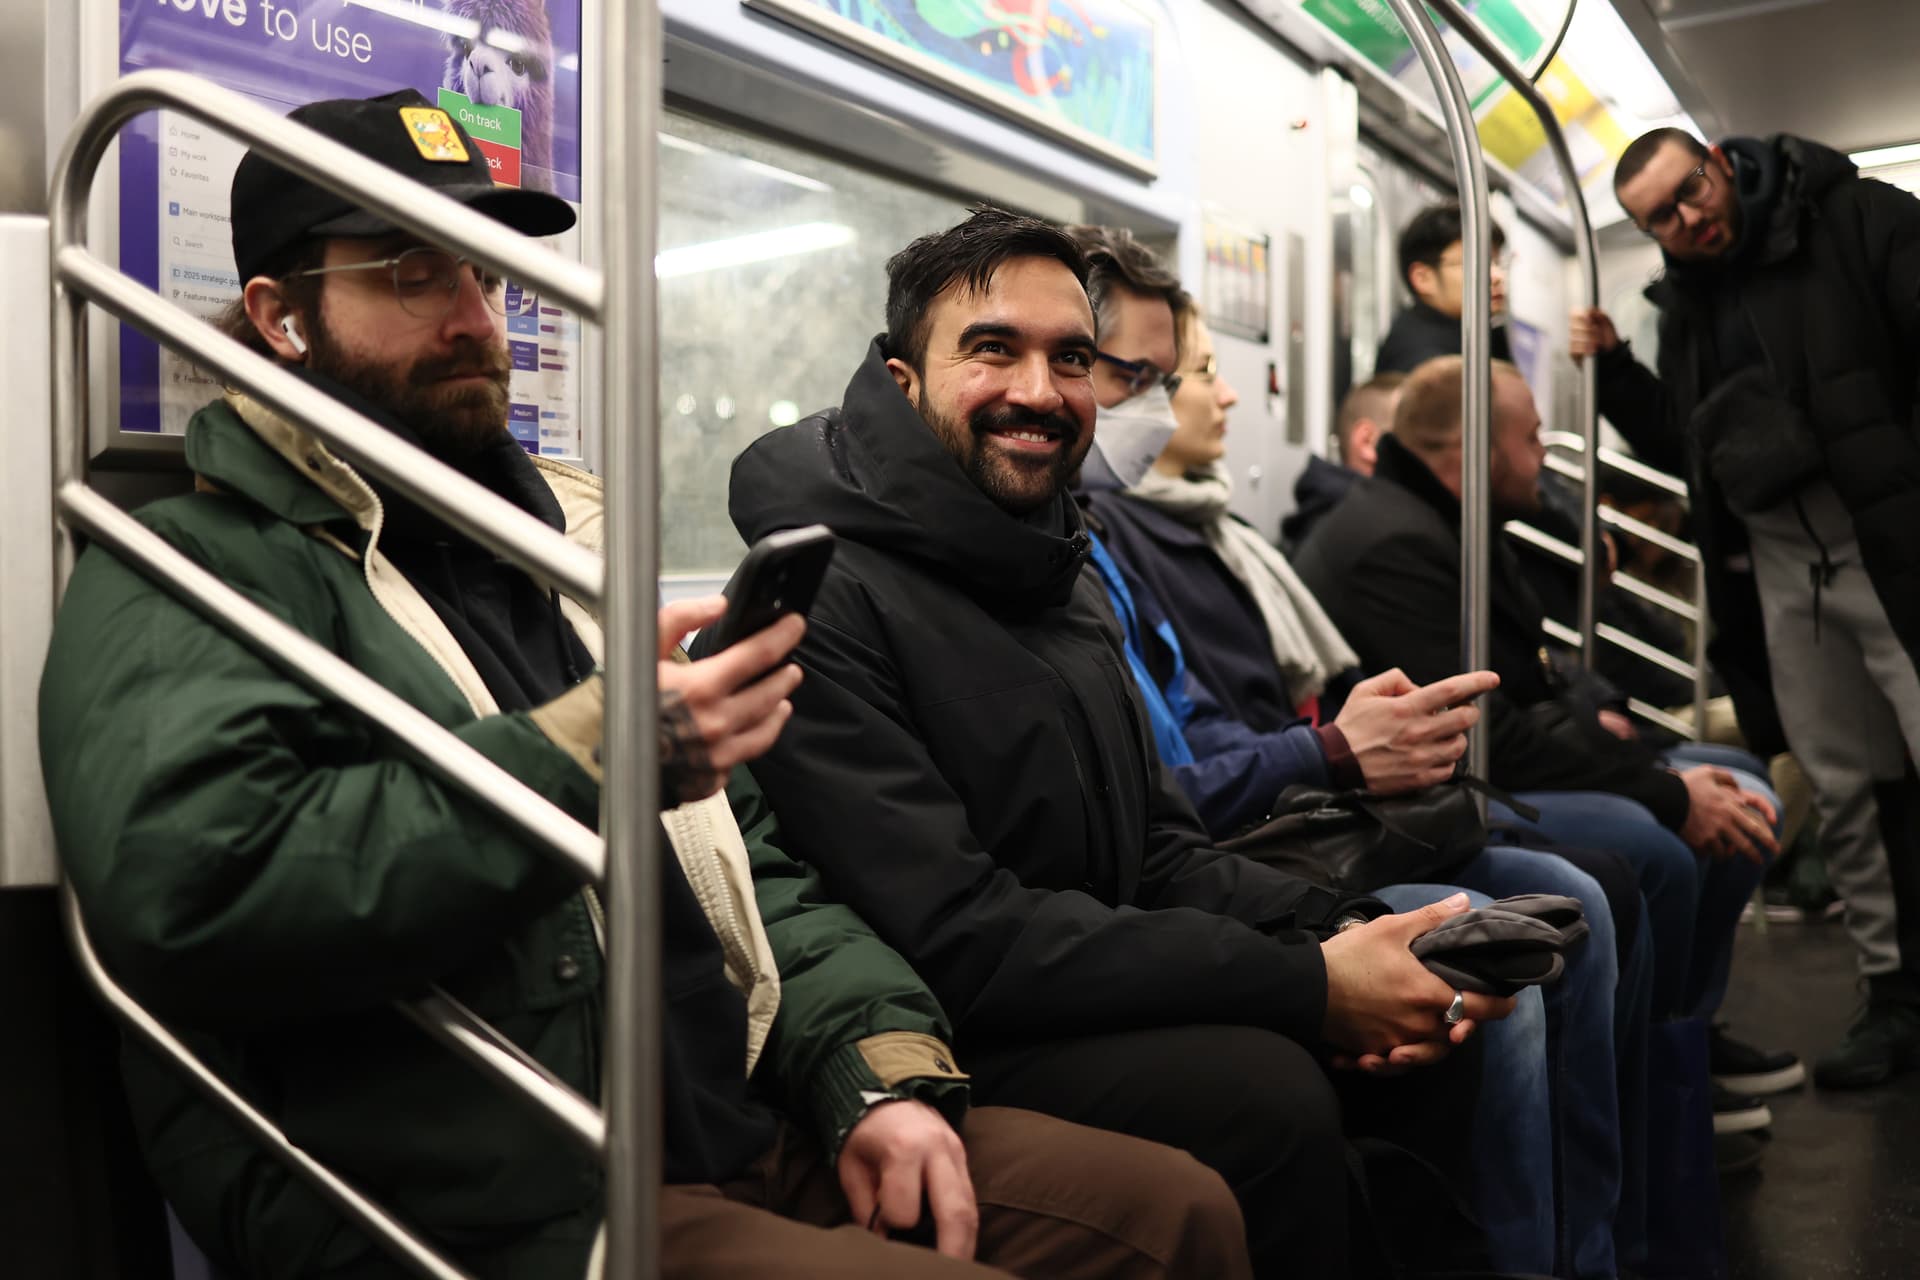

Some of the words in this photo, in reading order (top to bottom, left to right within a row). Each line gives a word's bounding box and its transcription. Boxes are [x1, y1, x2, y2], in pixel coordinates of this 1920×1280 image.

[259, 0, 298, 41] to
[312, 18, 372, 63] use
[459, 108, 474, 123] On
[476, 113, 502, 131] track
[181, 131, 200, 140] Home
[192, 153, 207, 161] work
[181, 169, 209, 182] Favorites
[183, 207, 198, 216] Main
[184, 270, 200, 280] 2025
[201, 273, 228, 286] strategic
[184, 291, 207, 301] Feature
